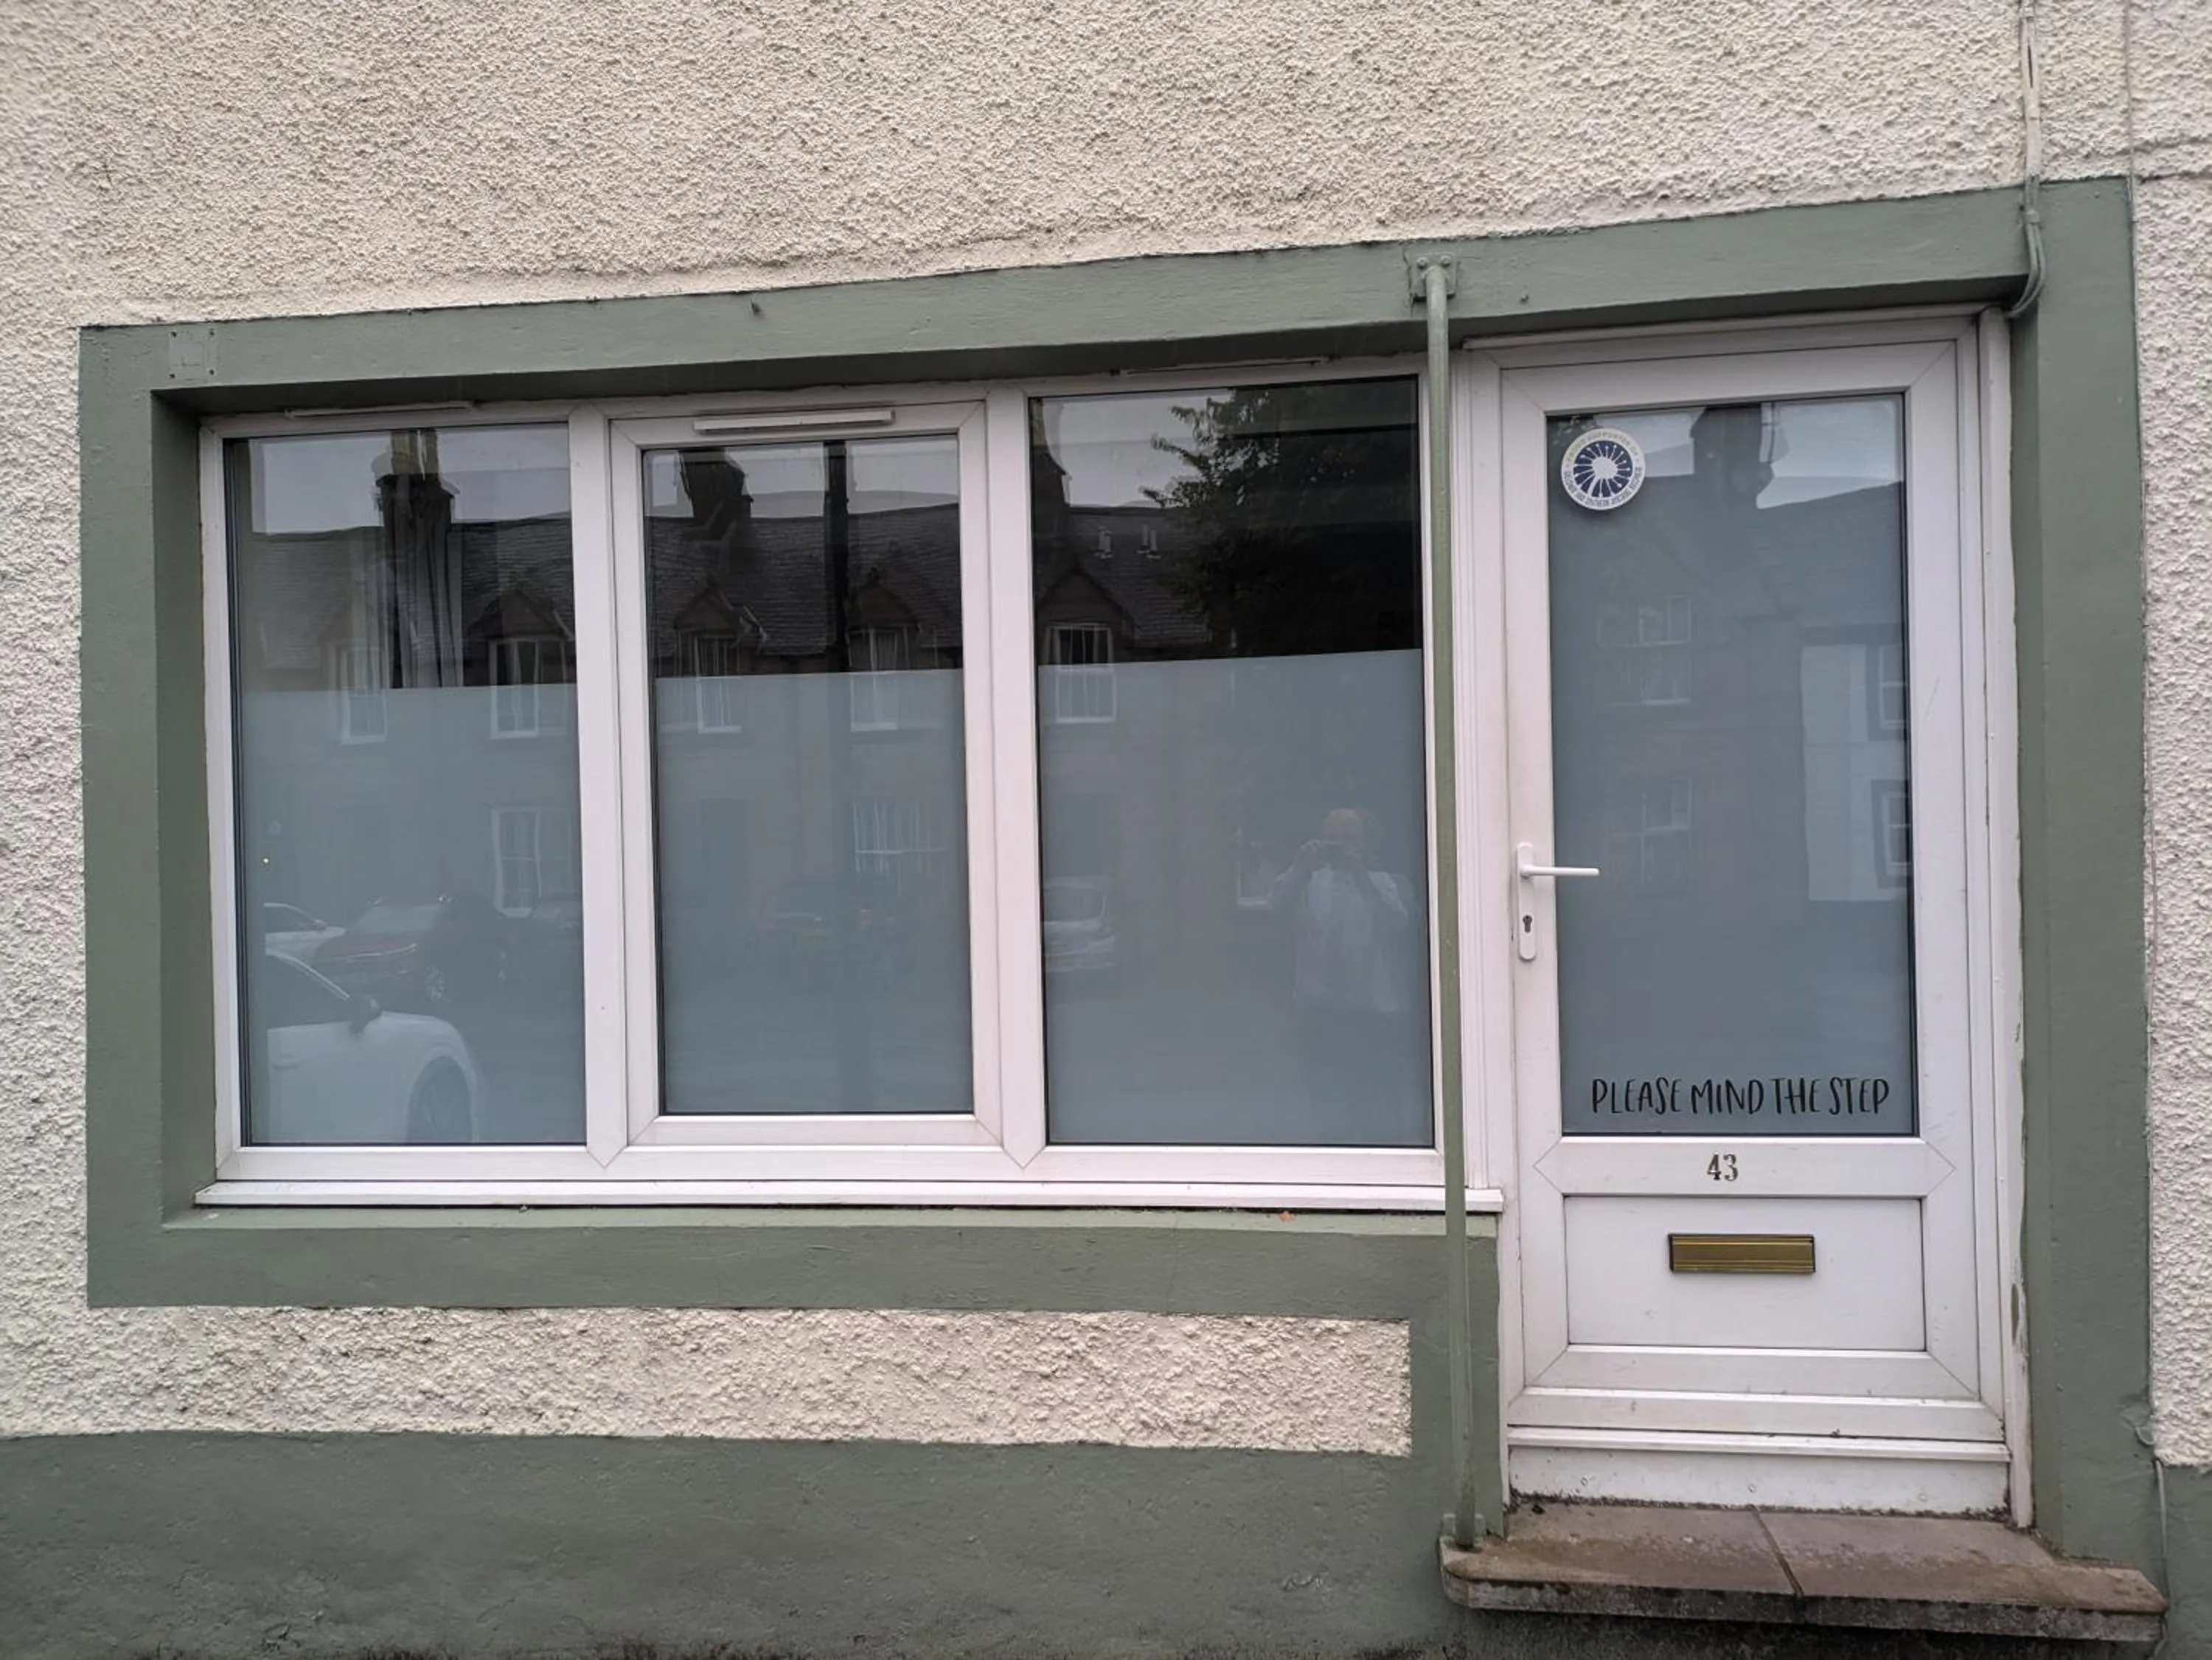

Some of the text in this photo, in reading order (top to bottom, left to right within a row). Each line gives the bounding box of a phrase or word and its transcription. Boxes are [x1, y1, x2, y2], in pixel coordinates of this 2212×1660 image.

[1592, 1077, 1890, 1115] PLEASE MIND THE STEP
[1706, 1153, 1739, 1182] 43
